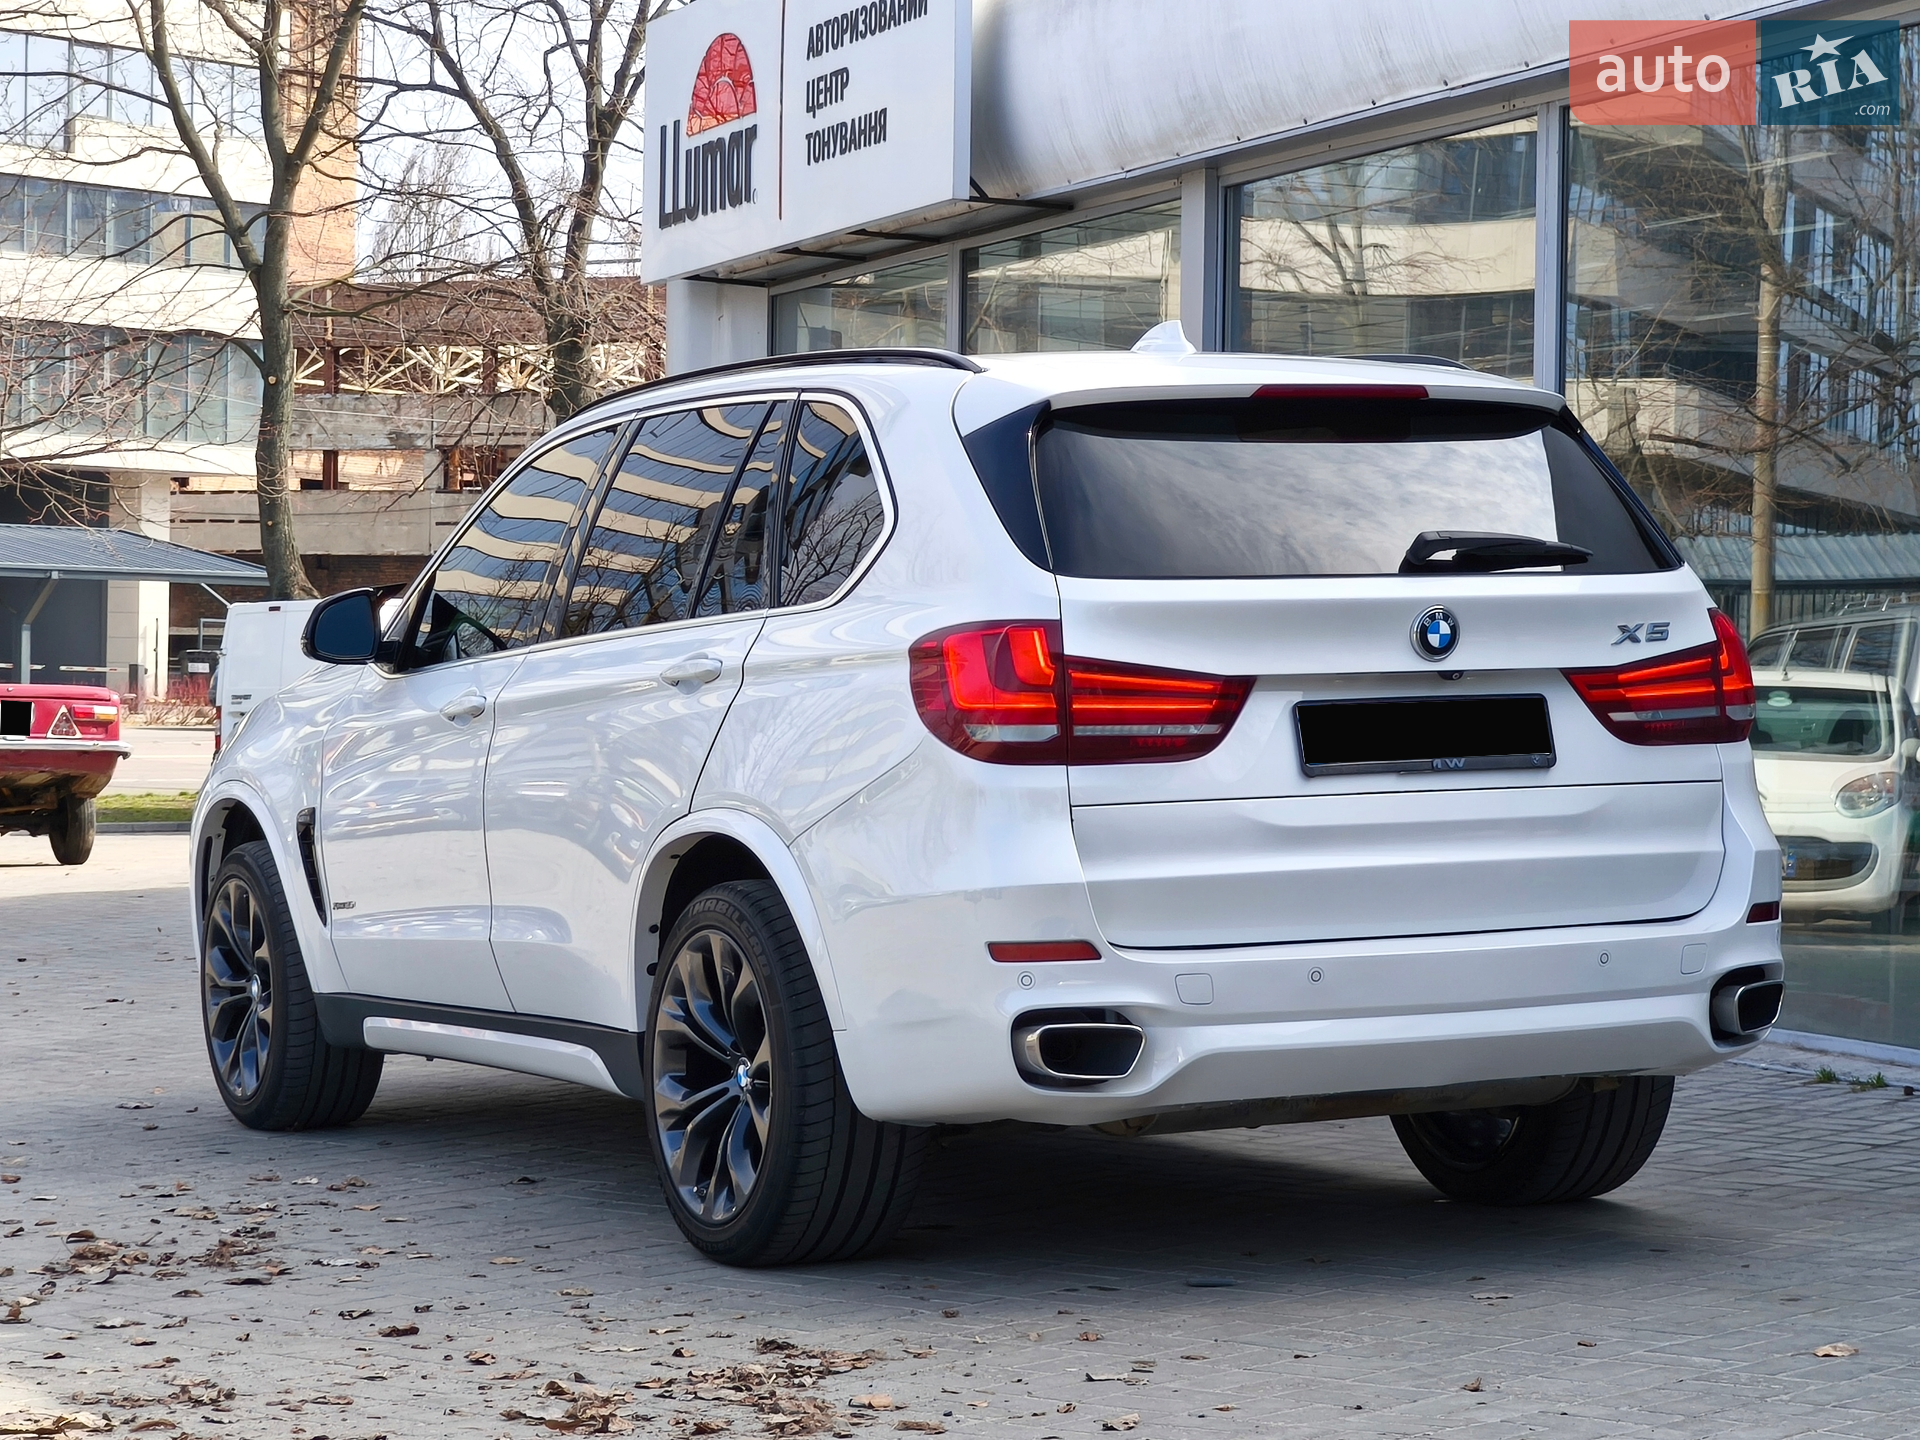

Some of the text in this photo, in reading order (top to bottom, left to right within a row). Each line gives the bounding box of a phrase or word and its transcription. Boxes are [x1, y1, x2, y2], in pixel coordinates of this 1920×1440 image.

[806, 67, 850, 118] ЦЕНТР
[805, 107, 888, 166] ТОНУВАННЯ
[659, 119, 758, 230] LLumar
[1423, 612, 1455, 627] BMW
[1610, 622, 1671, 645] X5
